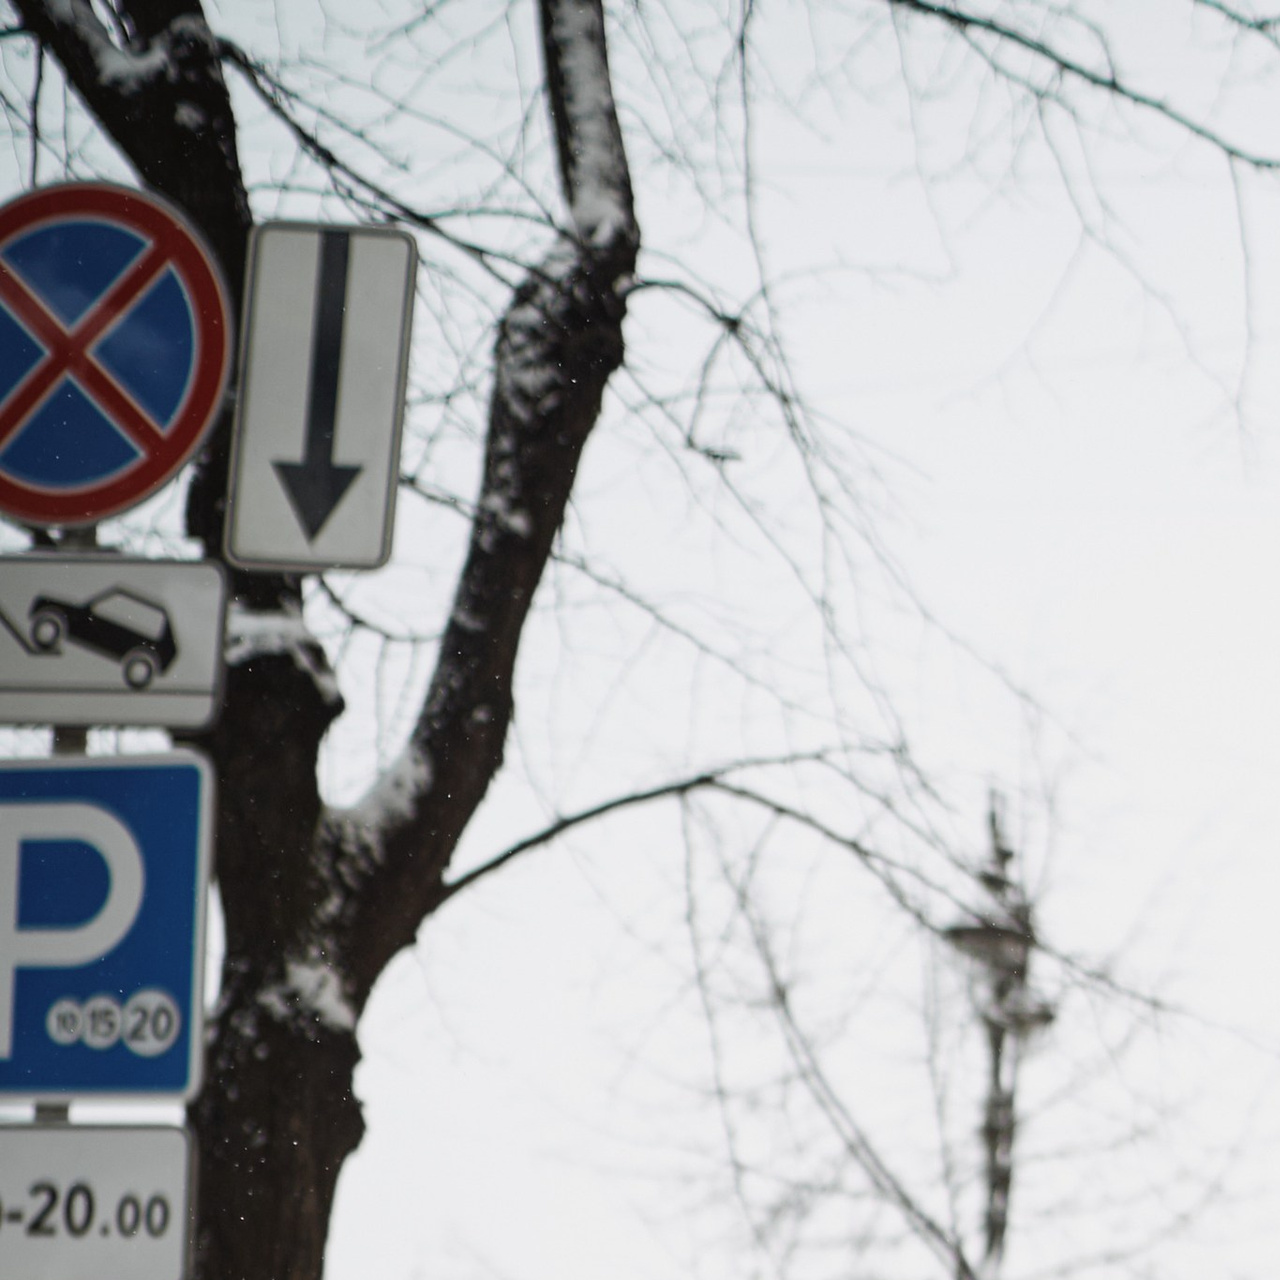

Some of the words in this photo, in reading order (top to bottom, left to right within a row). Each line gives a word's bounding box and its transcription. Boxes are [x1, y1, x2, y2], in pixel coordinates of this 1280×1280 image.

[0, 802, 145, 1061] P
[90, 1008, 116, 1038] 15
[129, 1006, 174, 1042] 20
[0, 1180, 171, 1239] -20.00
